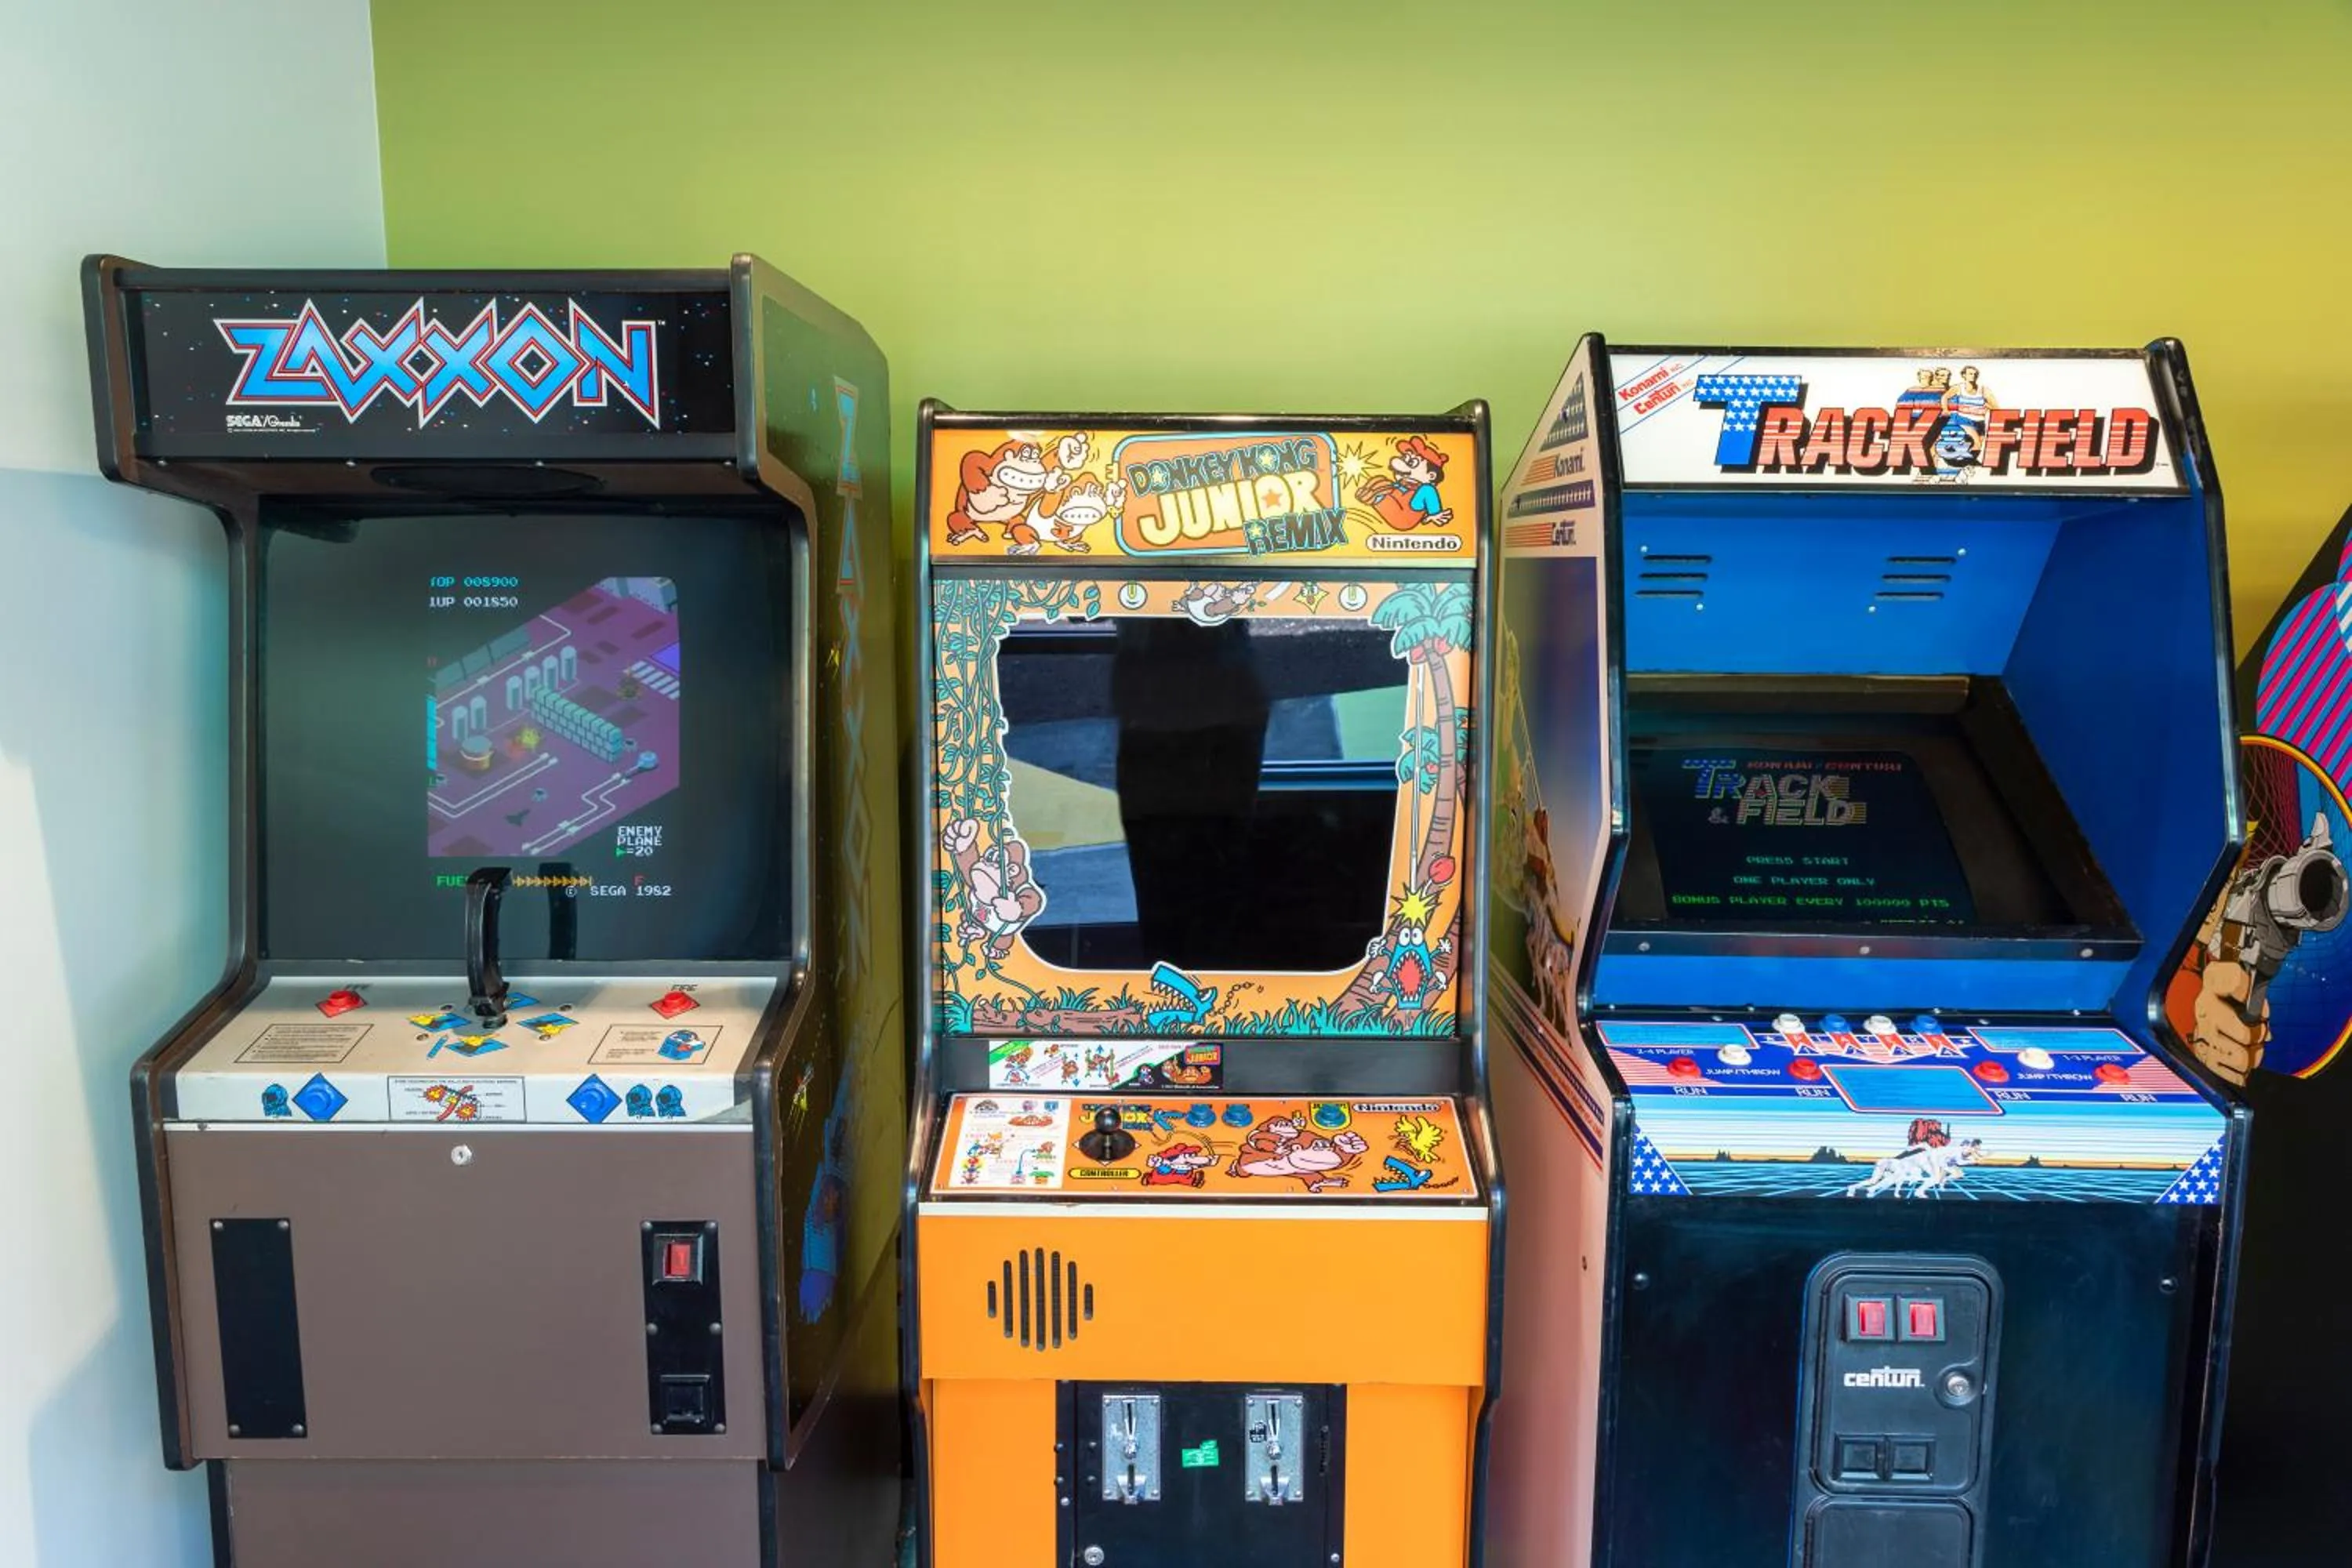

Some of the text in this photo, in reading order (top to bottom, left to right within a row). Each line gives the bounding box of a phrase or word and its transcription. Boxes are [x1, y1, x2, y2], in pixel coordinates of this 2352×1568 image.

[213, 296, 660, 430] ZAXXON
[1617, 366, 1669, 401] Konami
[1693, 374, 1943, 469] TRACK
[1981, 407, 2150, 469] FIELD
[1127, 438, 1319, 497] DONKEY KONG
[1137, 470, 1326, 546] JUNIOR
[1243, 509, 1348, 556] REMIX
[1372, 536, 1457, 550] Nintendo
[463, 576, 518, 587] 008900
[429, 597, 455, 608] 1UP
[1682, 759, 1847, 800] TRACK
[1708, 797, 1865, 826] & FIELD
[618, 826, 662, 837] ENEMY
[617, 836, 662, 846] PLANE
[1746, 855, 1849, 866] PRESS START
[436, 875, 467, 887] FUE
[1733, 876, 1875, 886] ONE PLAYER ONLY
[590, 886, 626, 896] SEGA
[636, 885, 672, 896] 1982
[1671, 895, 1722, 905] BONUS
[1729, 895, 1788, 906] PLAYER
[1795, 897, 1843, 906] EVERY
[1918, 898, 1951, 908] PTS
[1671, 1085, 1708, 1095] RUN
[1795, 1087, 1831, 1098] RUN
[1357, 1103, 1438, 1112] Nintendo
